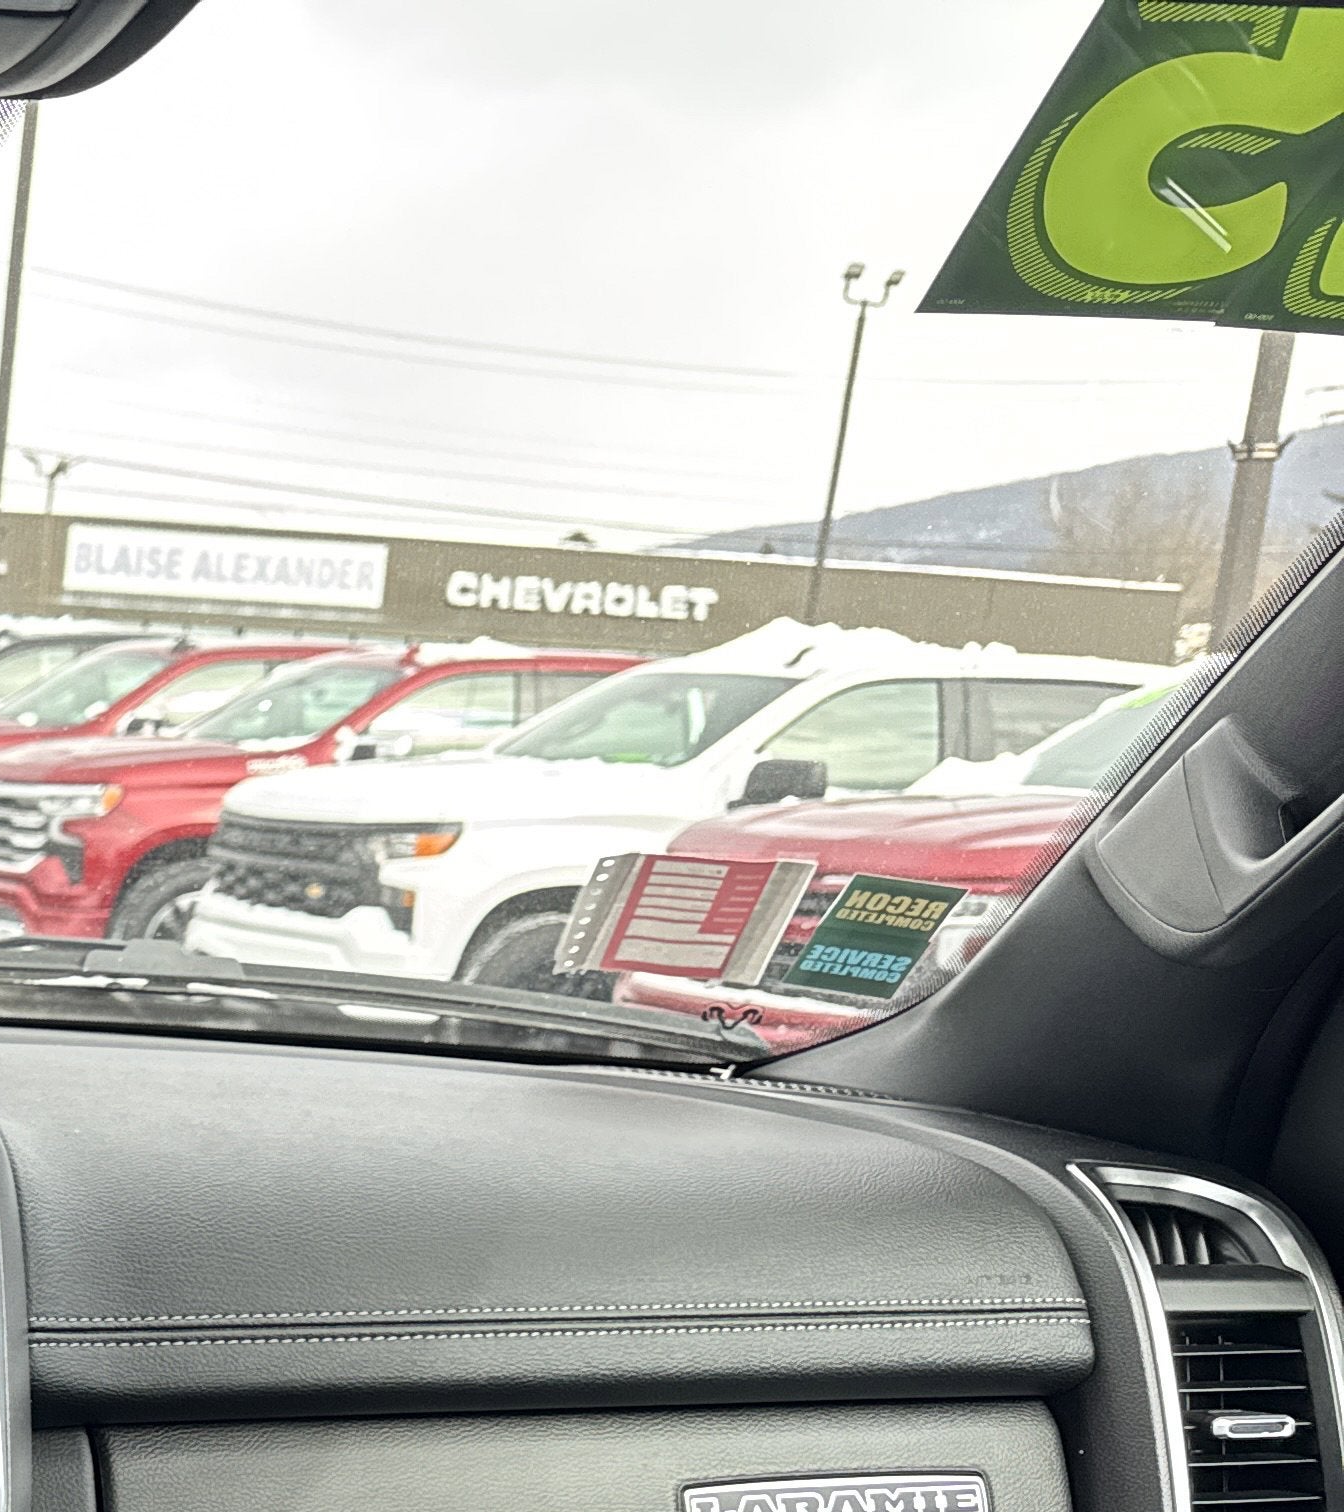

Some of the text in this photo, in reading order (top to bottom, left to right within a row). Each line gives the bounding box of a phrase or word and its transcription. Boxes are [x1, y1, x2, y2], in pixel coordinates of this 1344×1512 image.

[74, 542, 376, 591] BLAISE ALEXANDER
[446, 570, 719, 622] CHEVROLET
